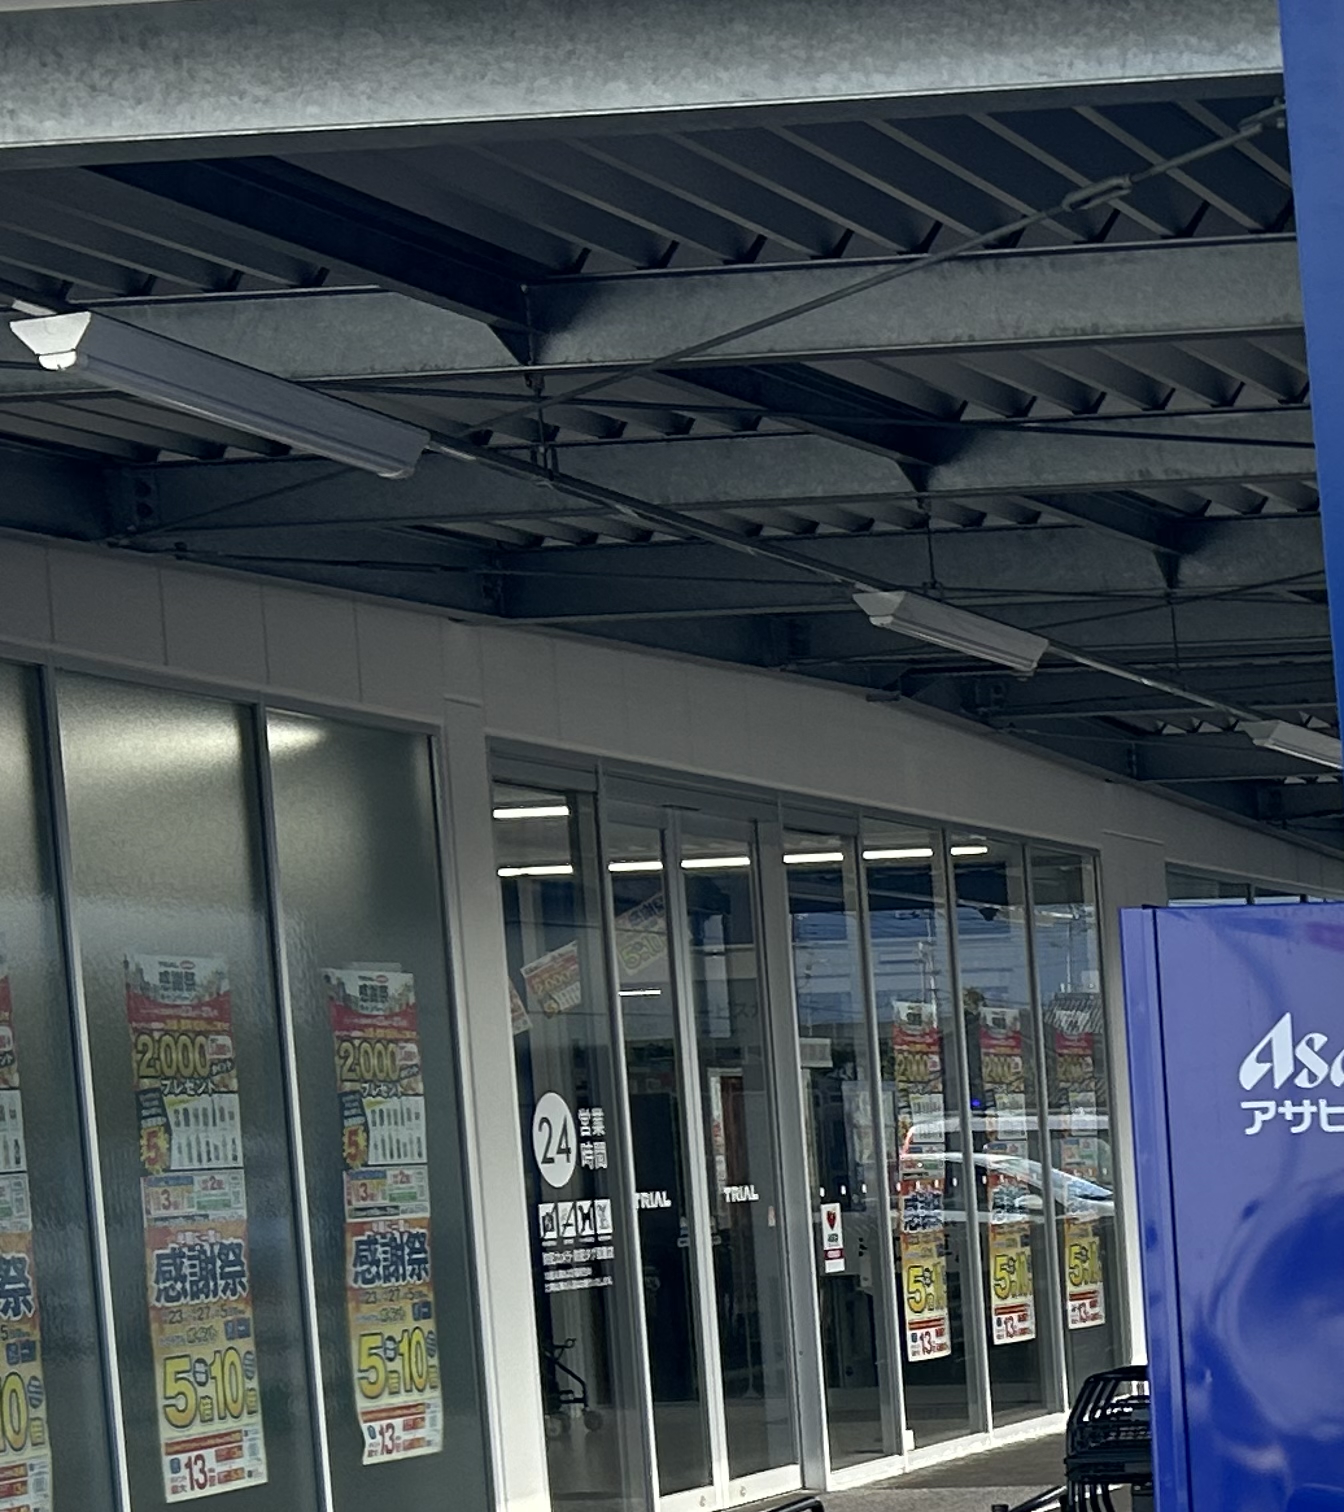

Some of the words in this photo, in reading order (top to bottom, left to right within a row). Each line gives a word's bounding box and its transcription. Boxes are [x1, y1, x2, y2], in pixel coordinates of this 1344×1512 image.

[538, 1115, 572, 1165] 24
[634, 1191, 672, 1209] TRIAL
[723, 1185, 759, 1202] TRIAL
[153, 1239, 249, 1305] 感謝祭
[352, 1228, 432, 1288] 感謝祭
[184, 1453, 209, 1491] 13
